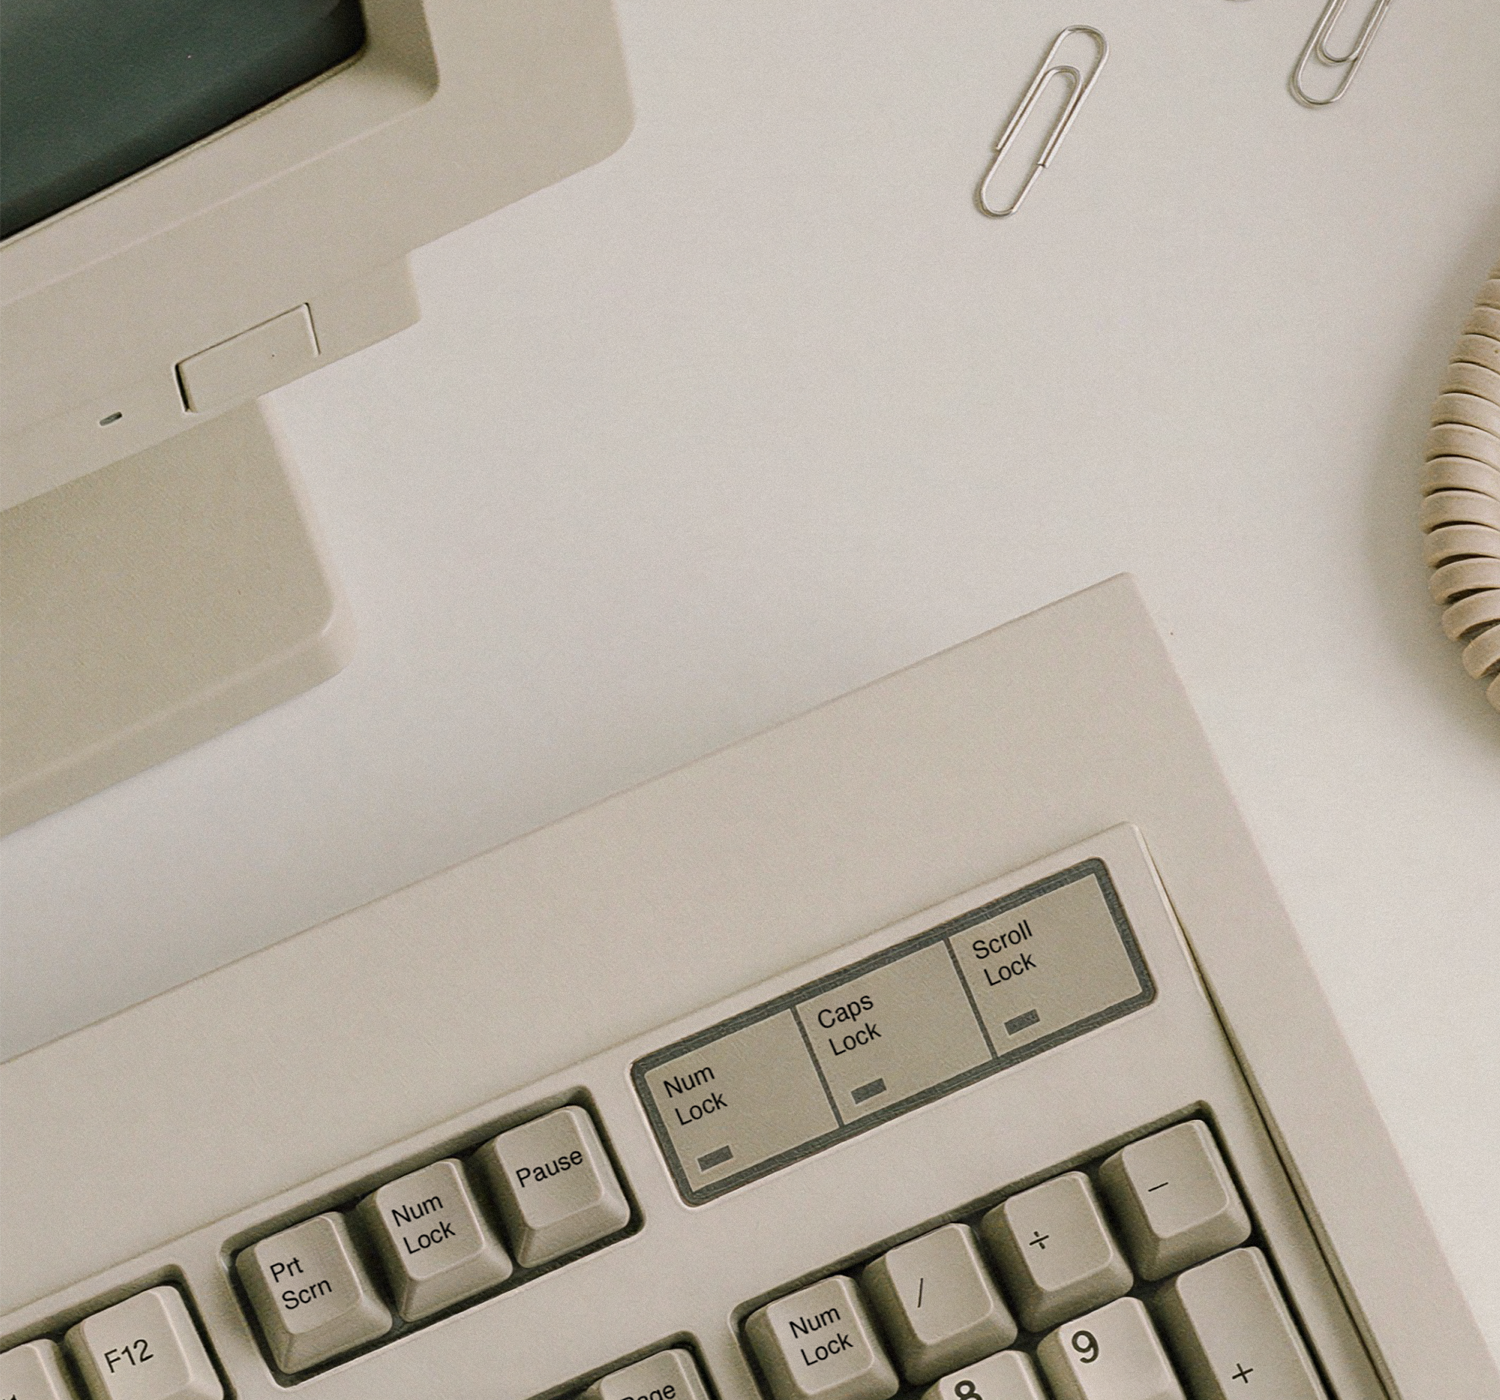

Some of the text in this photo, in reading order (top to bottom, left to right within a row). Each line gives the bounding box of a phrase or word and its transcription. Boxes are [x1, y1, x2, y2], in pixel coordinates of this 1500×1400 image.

[971, 918, 1034, 960] Scroll
[983, 952, 1038, 987] Lock
[817, 994, 875, 1029] Caps
[827, 1022, 883, 1057] Lock
[662, 1066, 716, 1099] Num
[674, 1092, 729, 1127] Lock
[515, 1150, 584, 1189] Pause
[391, 1195, 444, 1228] Num
[402, 1220, 457, 1255] Lock
[269, 1256, 305, 1284] Prt
[281, 1279, 333, 1310] Scrn
[788, 1307, 842, 1340] Num
[103, 1338, 155, 1374] F12
[799, 1332, 854, 1367] Lock
[1071, 1330, 1100, 1364] 9
